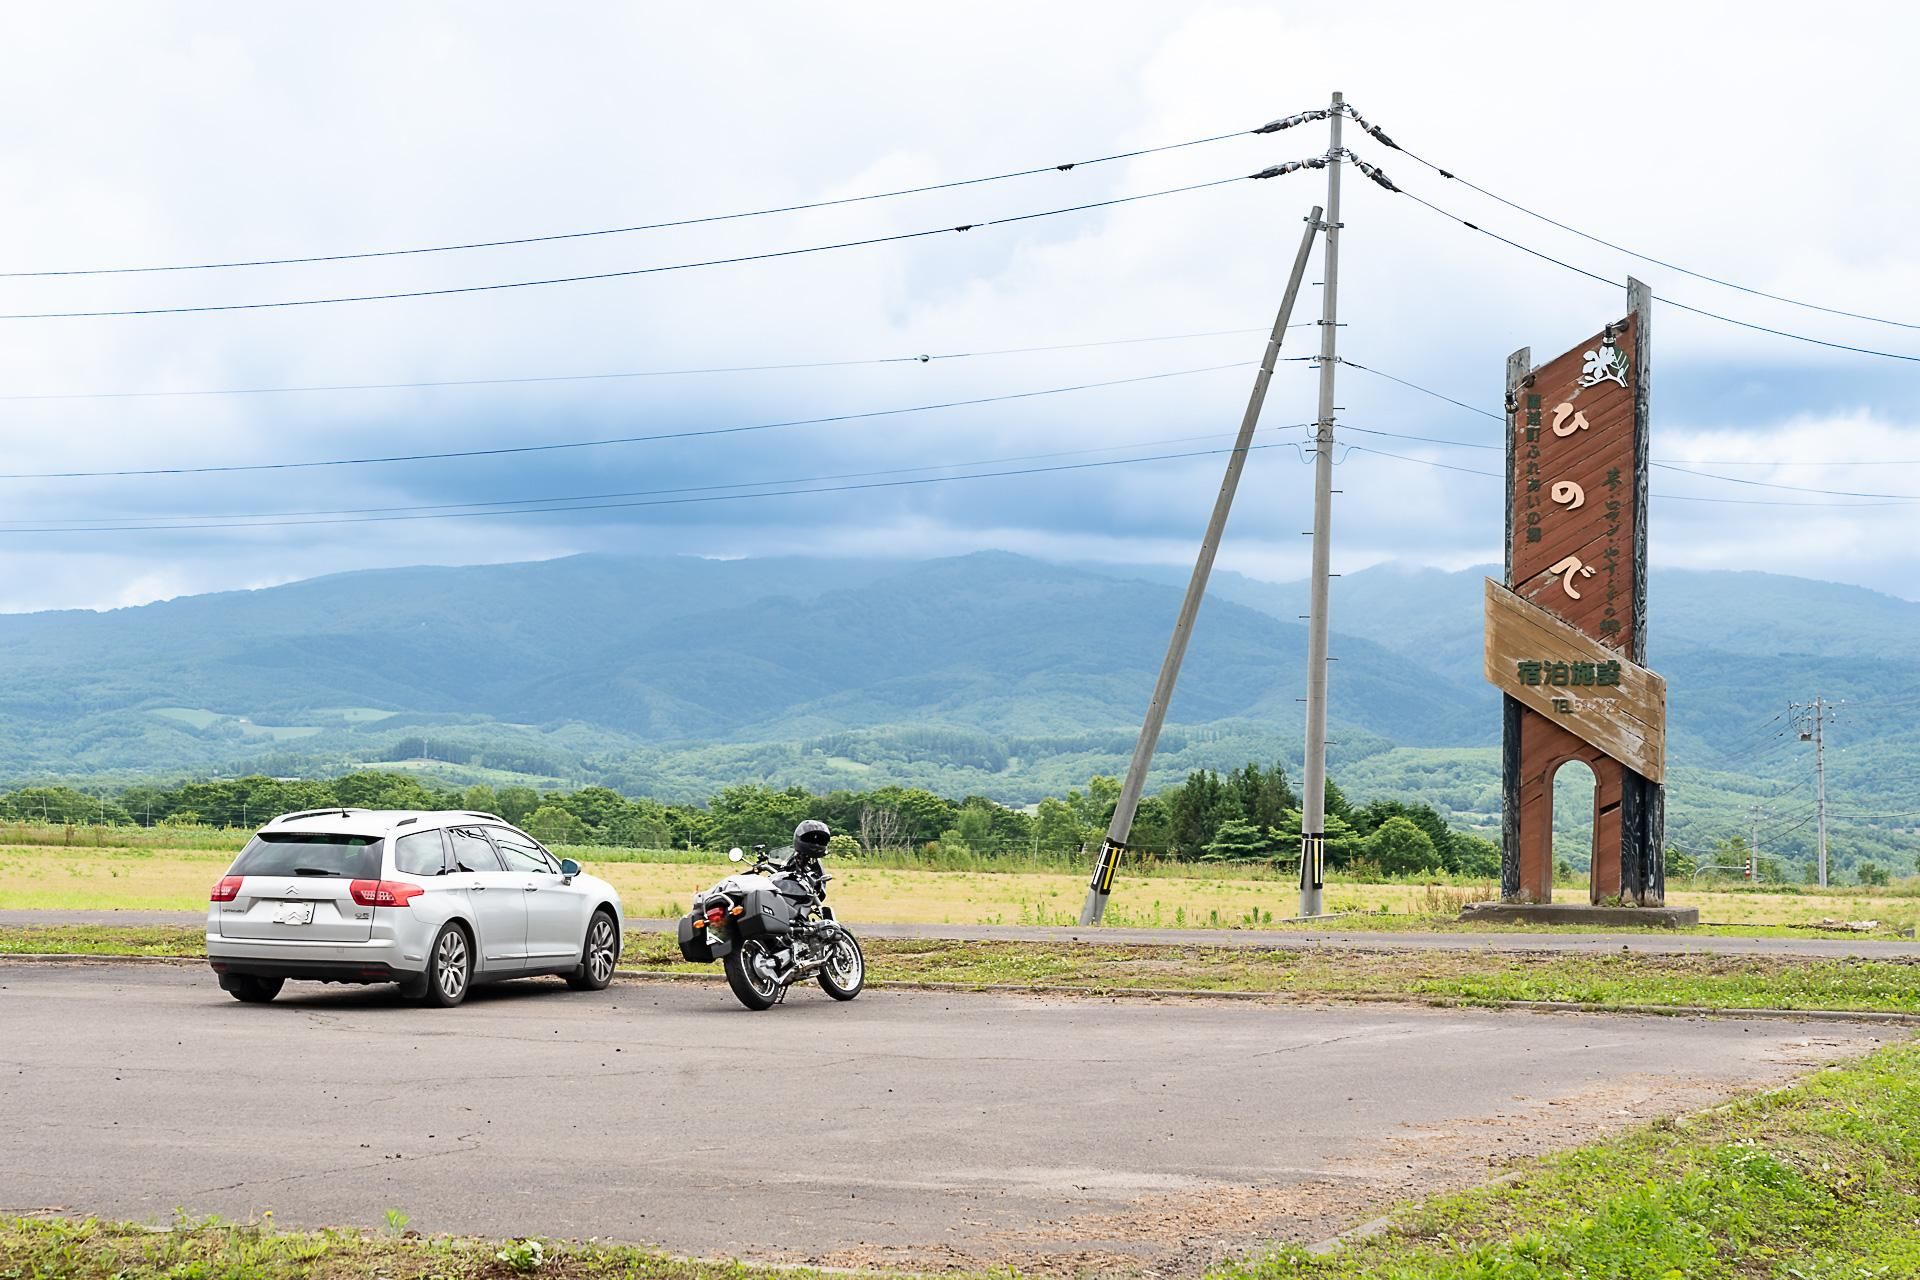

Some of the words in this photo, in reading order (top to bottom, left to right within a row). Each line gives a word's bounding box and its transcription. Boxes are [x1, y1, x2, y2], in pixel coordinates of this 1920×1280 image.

[1550, 402, 1597, 600] ひので
[1517, 659, 1621, 686] 宿泊施設
